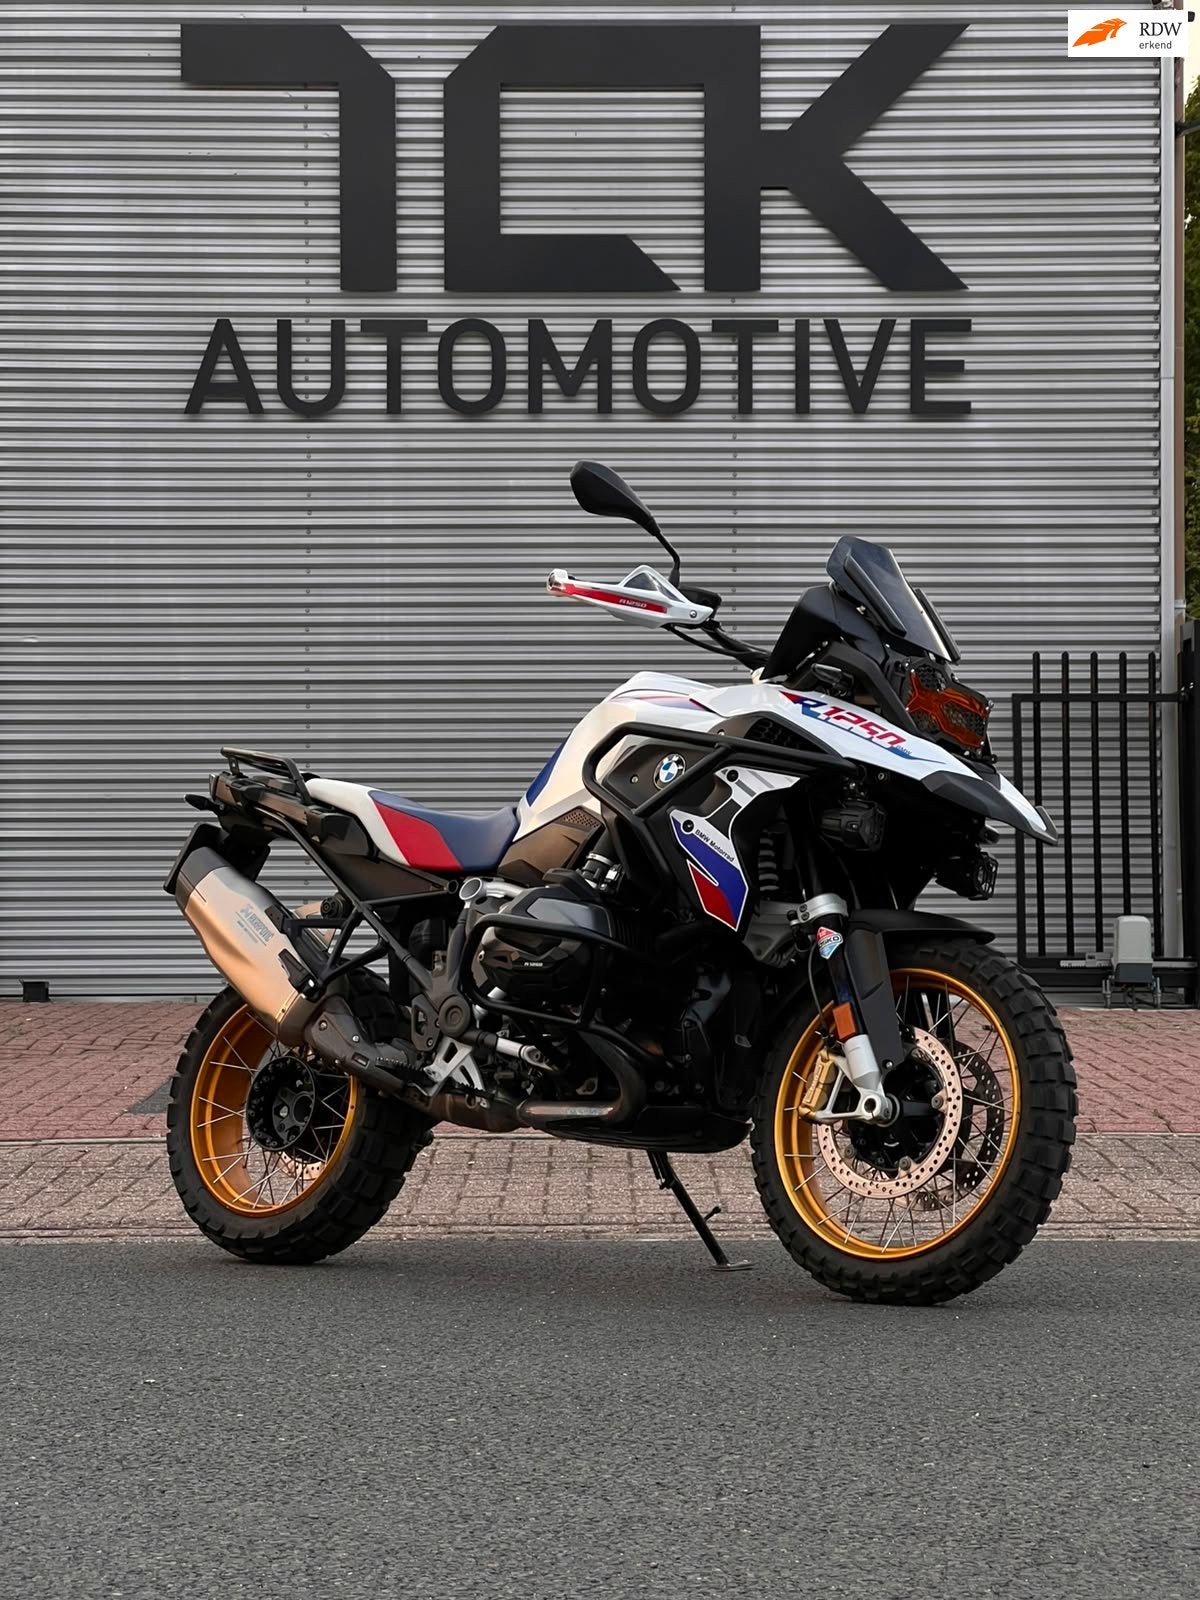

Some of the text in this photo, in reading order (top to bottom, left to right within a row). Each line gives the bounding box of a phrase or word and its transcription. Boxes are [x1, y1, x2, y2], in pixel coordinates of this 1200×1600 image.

[181, 25, 969, 291] TCK
[185, 318, 972, 415] AUTOMOTIVE
[694, 829, 735, 862] BMW Motorrad
